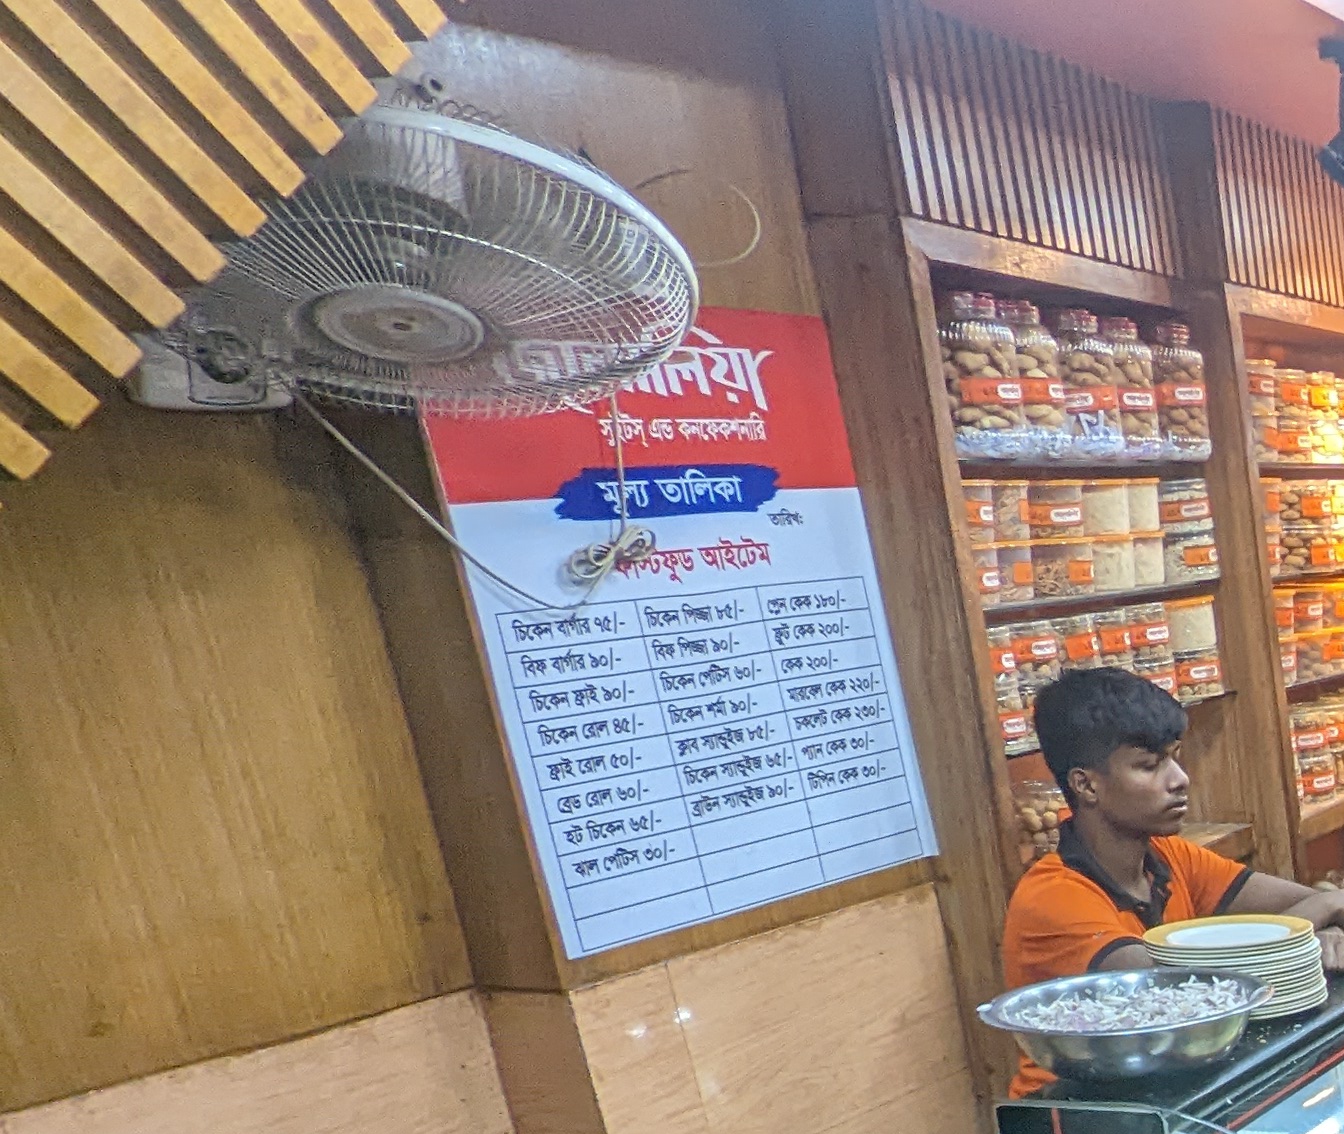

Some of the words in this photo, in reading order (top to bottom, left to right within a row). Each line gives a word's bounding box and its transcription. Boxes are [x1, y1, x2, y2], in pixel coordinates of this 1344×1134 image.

[674, 411, 767, 441] কনফেকশনারি
[596, 479, 649, 517] মূল্য
[653, 468, 743, 506] তালিকা
[697, 535, 773, 571] আইটেম
[644, 605, 681, 629] চিকেন
[681, 602, 712, 625] পিজ্জা
[714, 599, 744, 620] ৮৫/-
[789, 594, 812, 611] কেক
[814, 589, 846, 609] ১৮০/-
[511, 619, 553, 643] চিকেন
[556, 612, 591, 638] বার্গার
[594, 611, 626, 634] ৭৫/-
[793, 623, 815, 640] কেক
[818, 616, 849, 638] ২০০/-
[651, 638, 676, 661] বিফ
[677, 636, 709, 658] পিজ্জা
[709, 632, 740, 653] ৯০/-
[781, 656, 803, 674] কেক
[806, 649, 838, 671] ২০০/-
[520, 654, 547, 678] বিফ
[549, 649, 586, 674] বার্গার
[588, 647, 622, 670] ৯০/-
[659, 671, 696, 693] চিকেন
[733, 659, 761, 680] ৬০/-
[529, 689, 571, 713] চিকেন
[572, 683, 600, 707] ফ্রাই
[601, 680, 635, 703] ৯০/-
[825, 679, 847, 697] কেক
[849, 671, 879, 693] ২২০/-
[667, 703, 704, 725] চিকেন
[728, 692, 758, 714] ৯০/-
[830, 707, 852, 724] কেক
[537, 724, 579, 747] চিকেন
[582, 720, 610, 740] রোল
[612, 712, 644, 735] ৪৫/-
[745, 720, 775, 741] ৮৫/-
[801, 743, 824, 761] প্যান
[826, 738, 847, 756] কেক
[850, 730, 875, 751] ৩০/-
[547, 757, 578, 782] ফ্রাই
[576, 754, 607, 775] রোল
[610, 746, 642, 769] ৫০/-
[683, 765, 719, 786] চিকেন
[765, 747, 793, 768] ৬৫/-
[838, 766, 859, 784] কেক
[862, 758, 887, 779] ৩০/-
[585, 788, 613, 808] রোল
[616, 778, 650, 801] ৬০/-
[765, 777, 794, 798] ৯০/-
[563, 824, 583, 846] হট
[586, 819, 627, 841] চিকেন
[629, 809, 662, 832] ৬৫/-
[643, 838, 676, 862] ৩০/-
